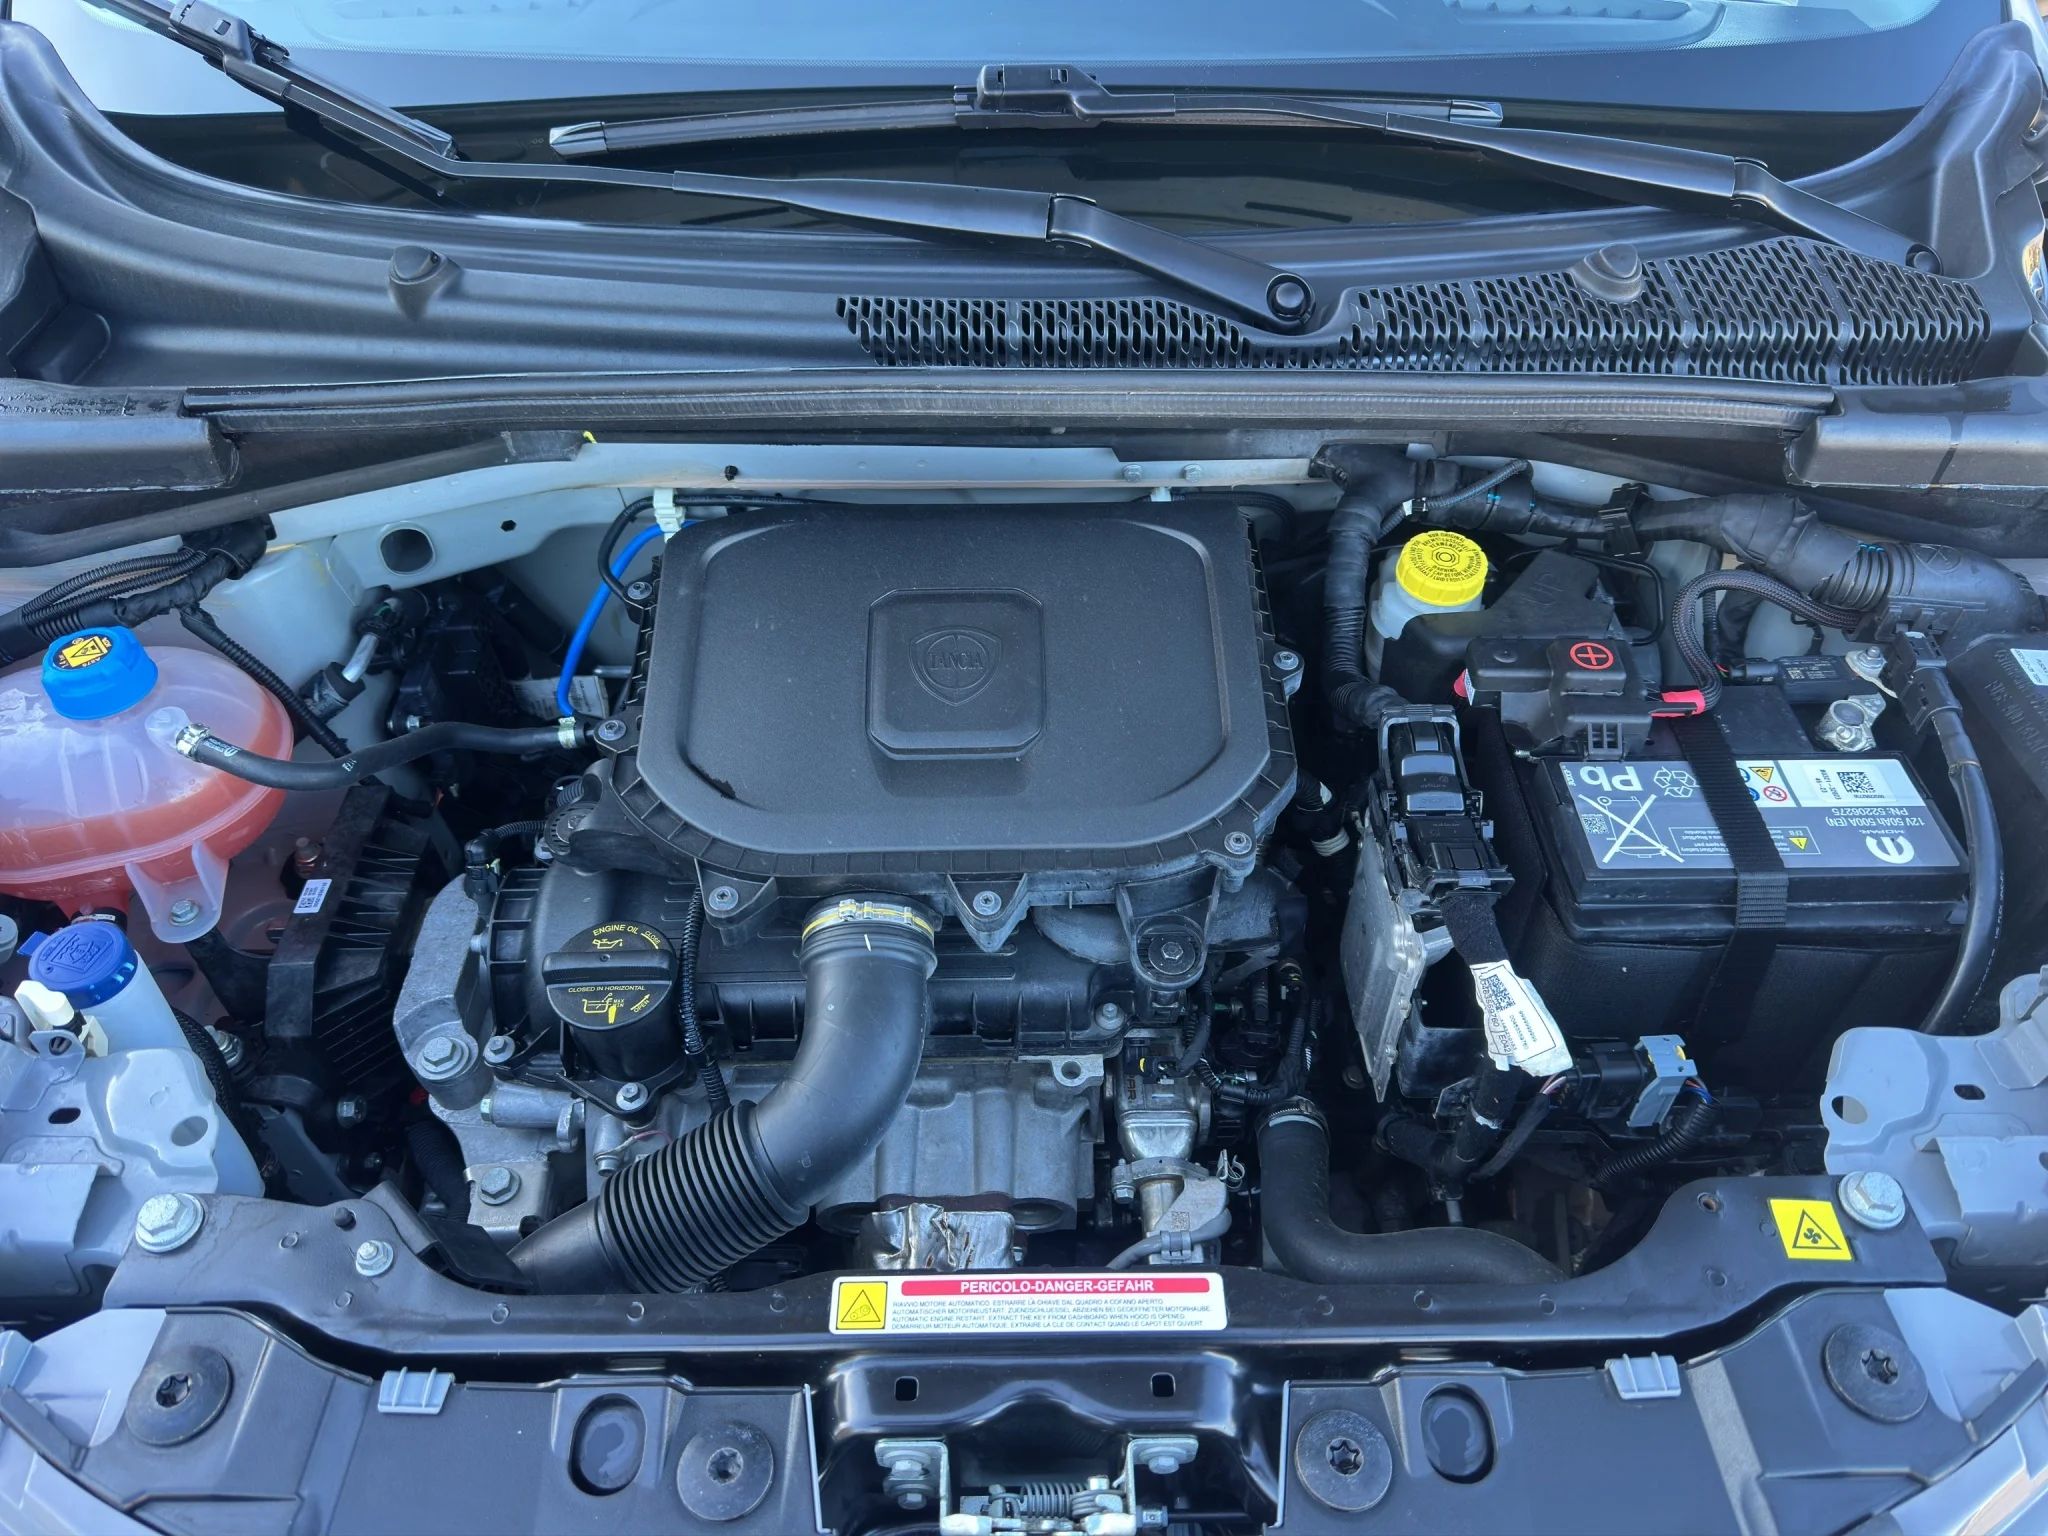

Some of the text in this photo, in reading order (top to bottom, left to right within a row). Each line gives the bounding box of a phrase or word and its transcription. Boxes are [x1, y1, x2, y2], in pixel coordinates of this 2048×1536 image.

[1579, 765, 1643, 791] Pb
[1832, 807, 1908, 816] PN: 52206275
[1825, 817, 1925, 827] 12V 50Ah 500A (EN)
[593, 924, 639, 936] ENGINE OIL
[644, 930, 661, 944] CLOSE
[633, 999, 650, 1013] OPEN
[960, 1280, 1155, 1293] PERICOLO-DANGER-GEFAHR
